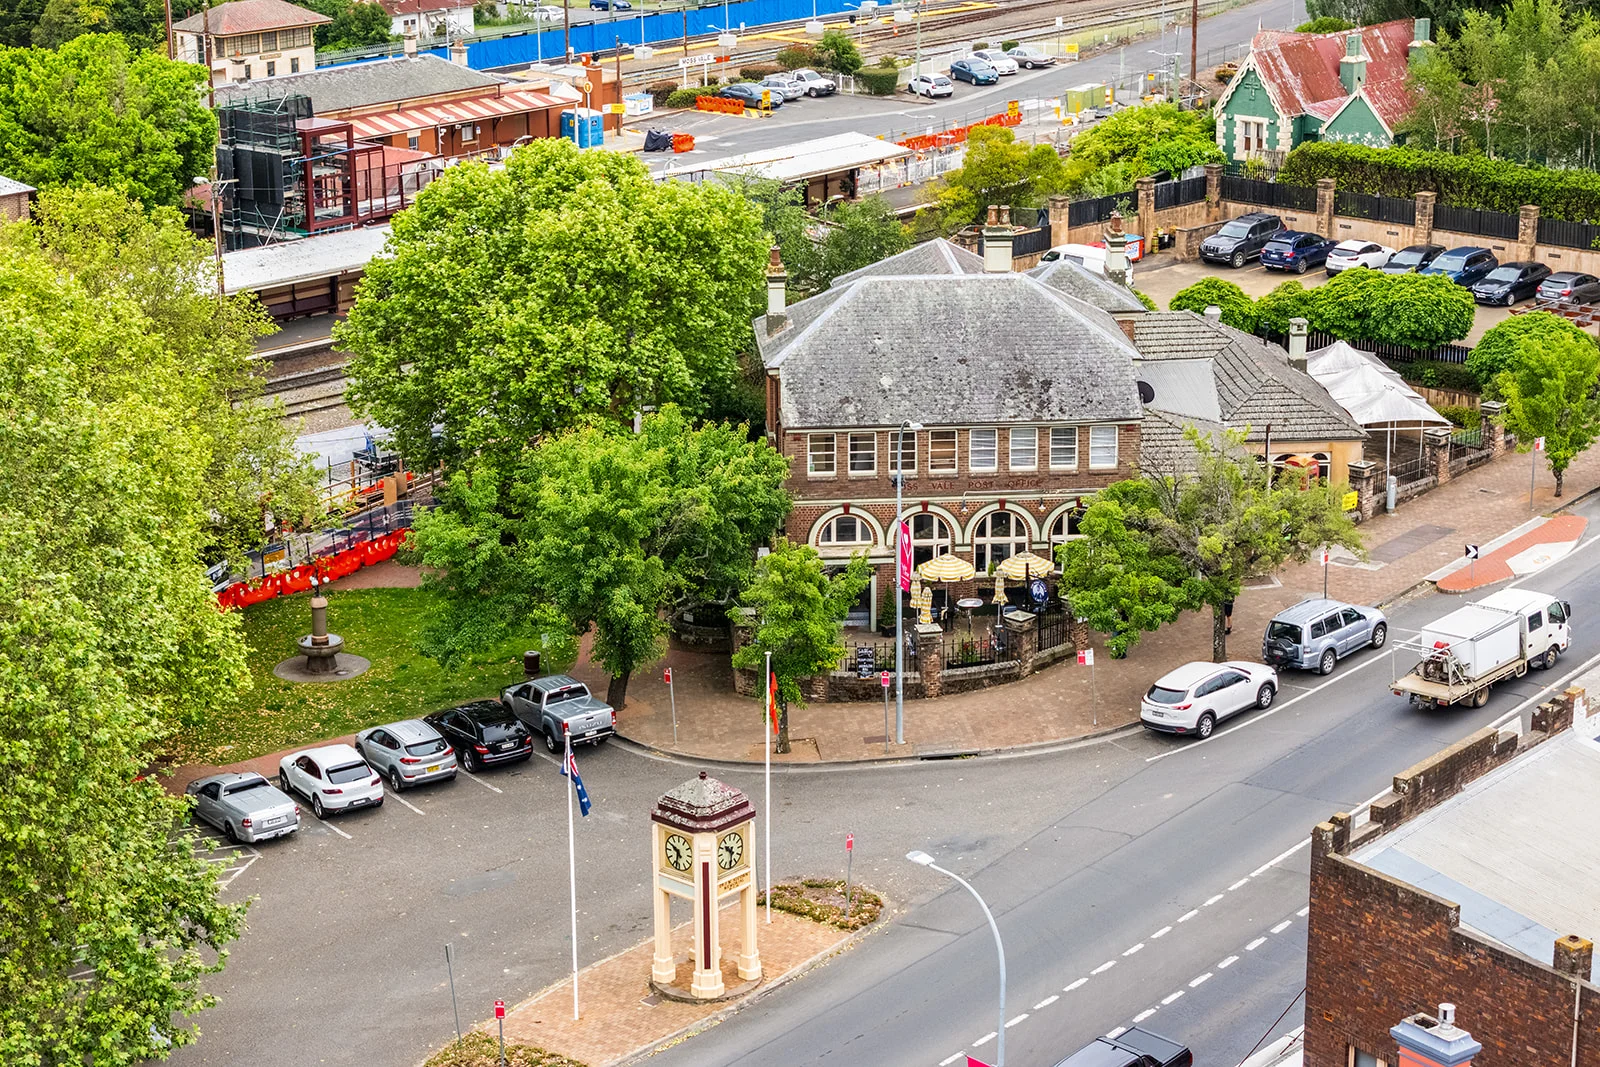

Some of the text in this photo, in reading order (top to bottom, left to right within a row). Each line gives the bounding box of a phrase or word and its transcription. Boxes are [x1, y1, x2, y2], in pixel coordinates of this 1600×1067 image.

[931, 480, 955, 490] VALE
[968, 480, 995, 489] POST
[1007, 478, 1044, 489] OFFICE
[578, 720, 603, 730] ISUZU
